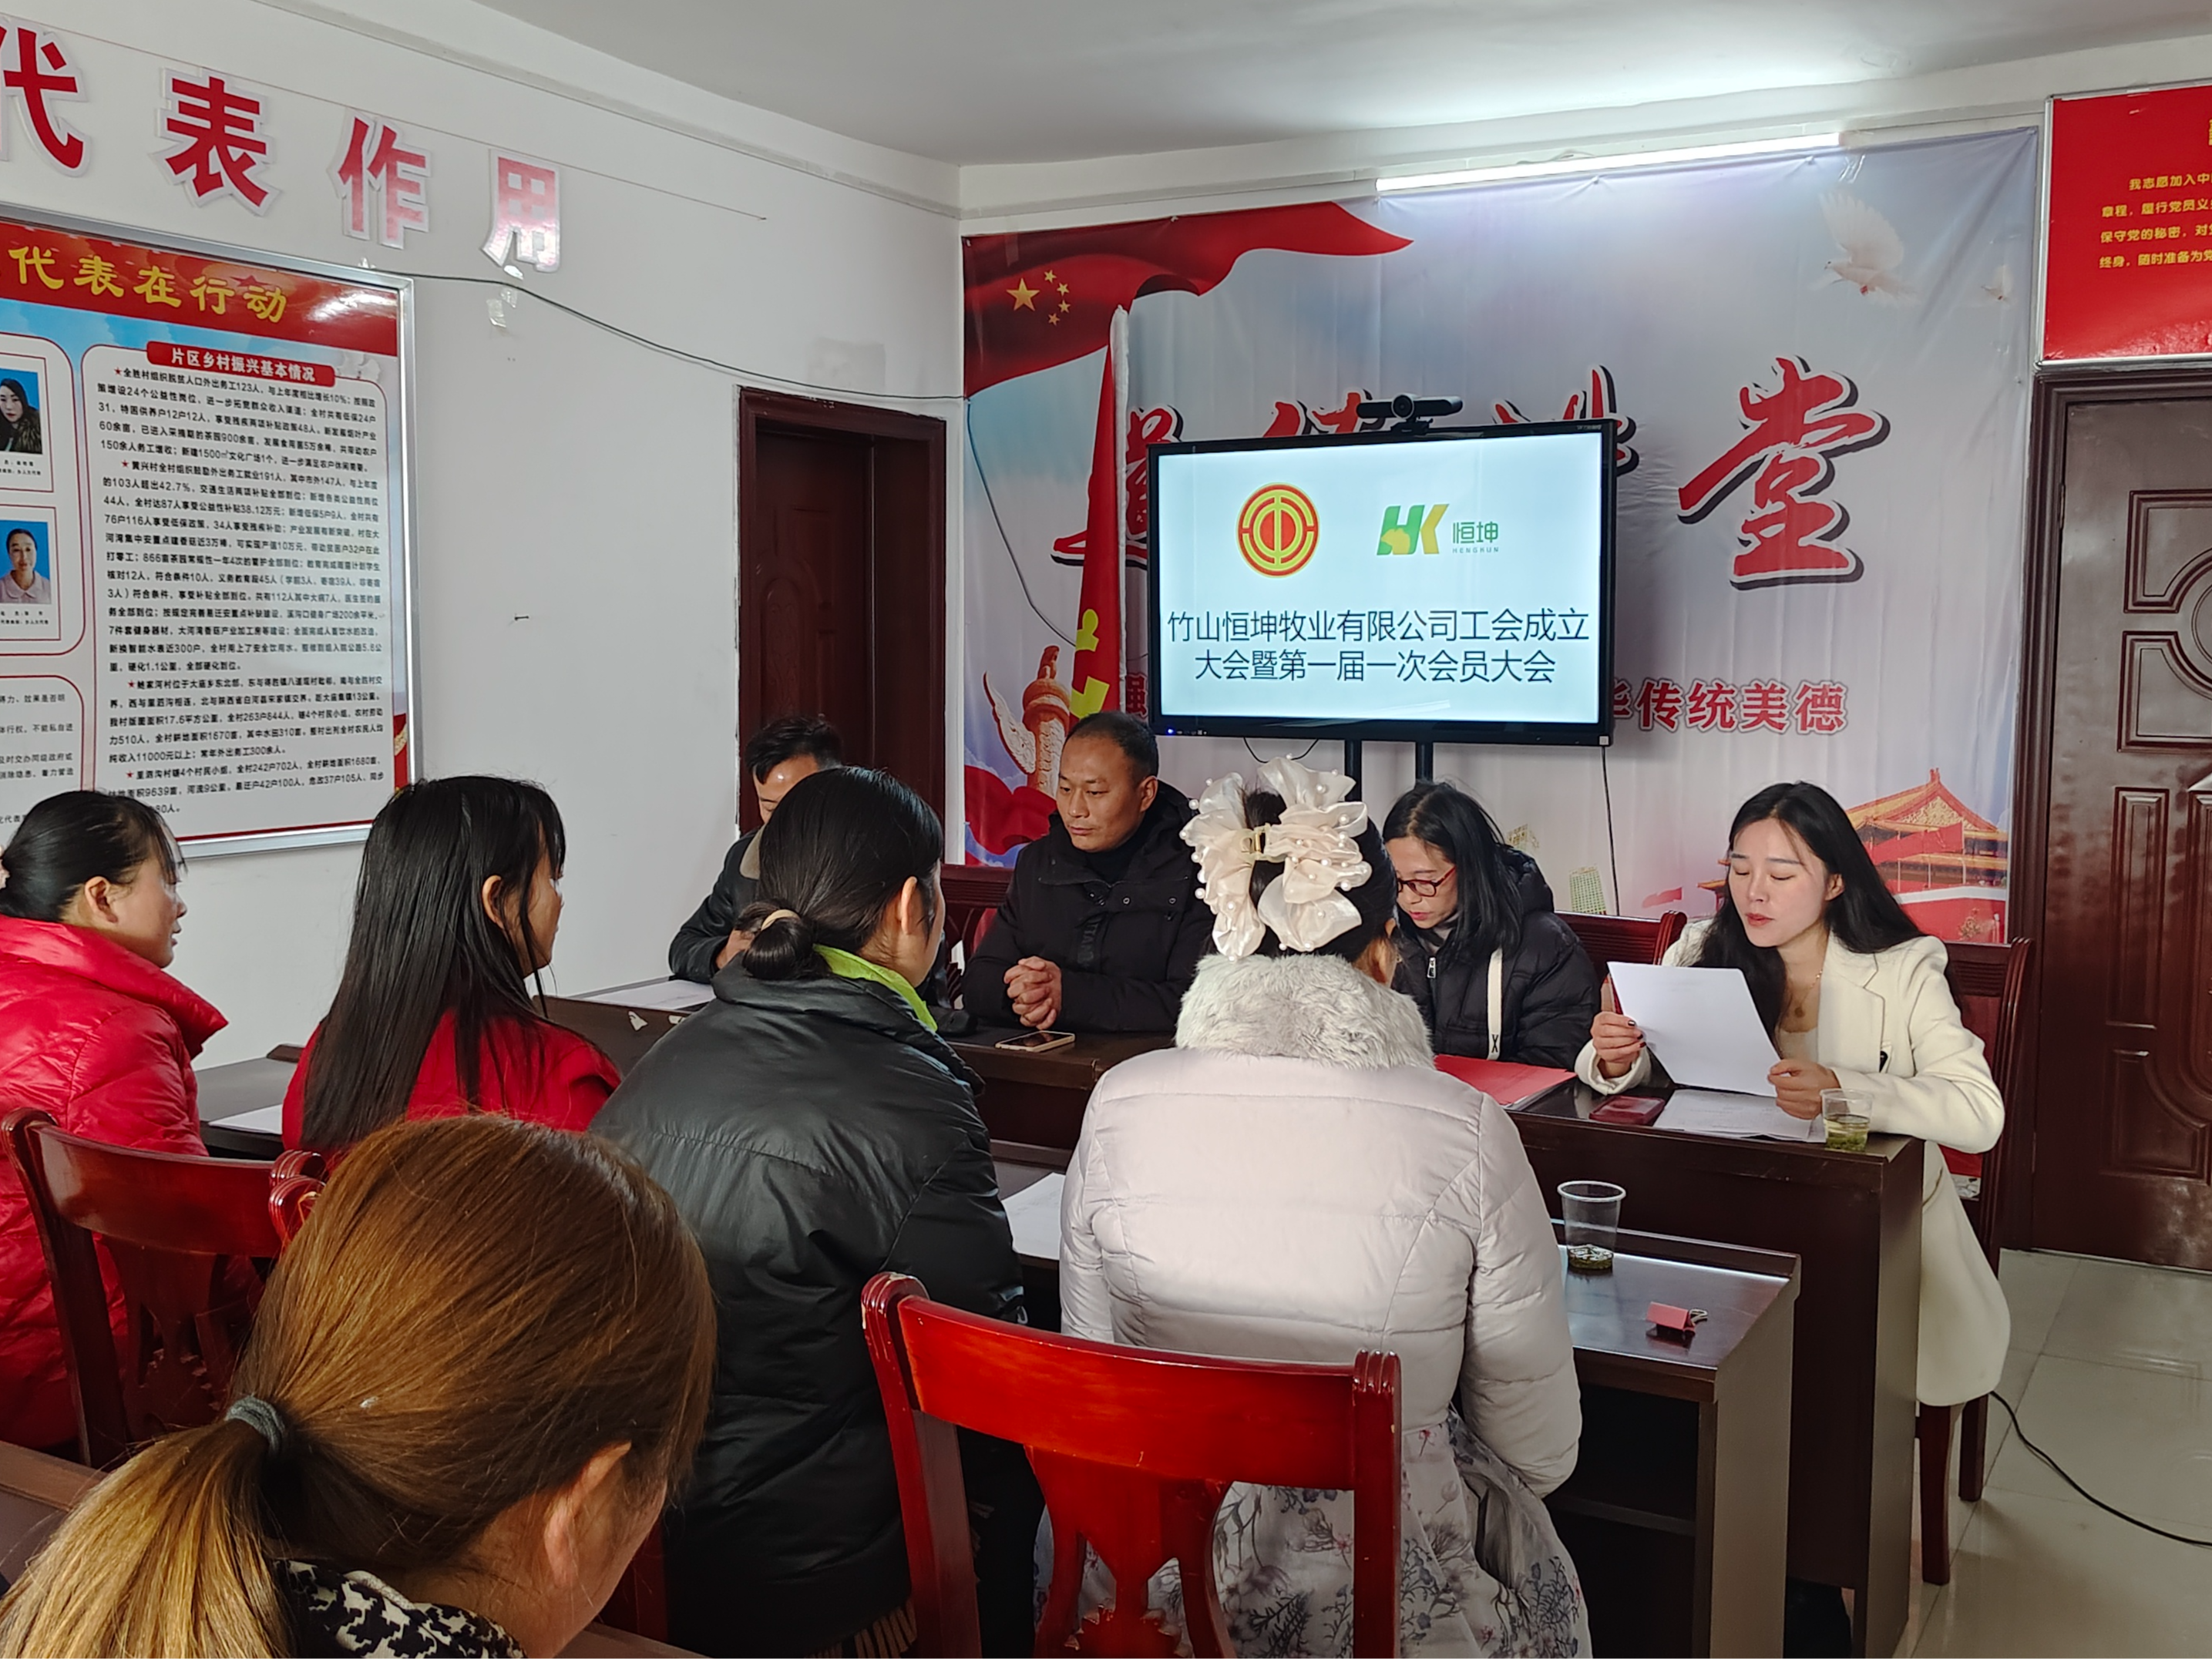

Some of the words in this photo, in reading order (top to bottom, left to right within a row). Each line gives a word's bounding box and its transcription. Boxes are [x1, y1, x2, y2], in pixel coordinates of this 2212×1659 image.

[2129, 173, 2212, 191] 我志愿加入中
[2102, 198, 2212, 217] 章程，履行党员义
[2100, 223, 2212, 243] 保守党的秘密，对
[8, 245, 288, 324] 代表在行动
[171, 348, 315, 382] 片区乡村振兴基本情况
[1453, 522, 1498, 544] 恒坤
[1167, 607, 1589, 643] 竹山恒坤牧业有限公司工会成立
[1195, 648, 1556, 683] 大会暨第一届一次会员大会
